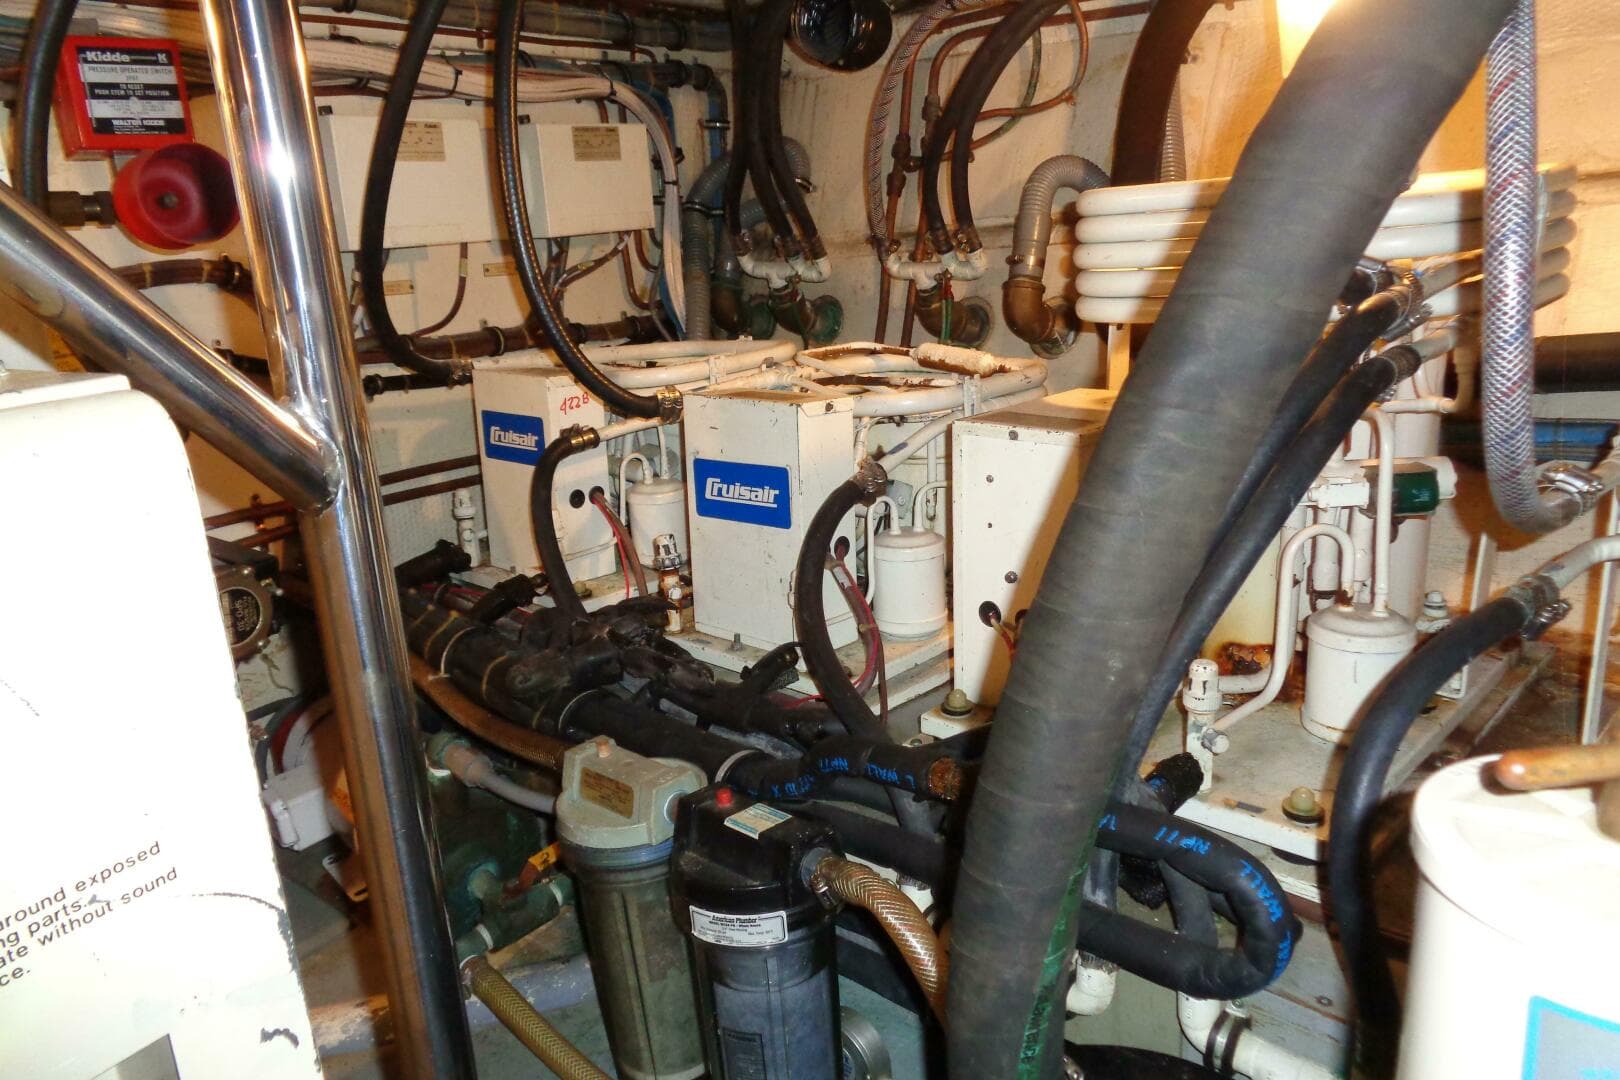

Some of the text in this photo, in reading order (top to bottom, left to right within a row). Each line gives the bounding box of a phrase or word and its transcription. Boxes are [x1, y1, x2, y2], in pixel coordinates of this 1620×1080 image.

[85, 50, 130, 63] Kidde
[489, 426, 539, 451] Cruisair
[704, 477, 780, 508] Cruisair
[74, 840, 161, 893] exposed
[27, 899, 88, 939] parts.
[37, 901, 114, 947] without
[120, 866, 178, 905] sound
[711, 915, 735, 924] American
[0, 966, 31, 988] ce.
